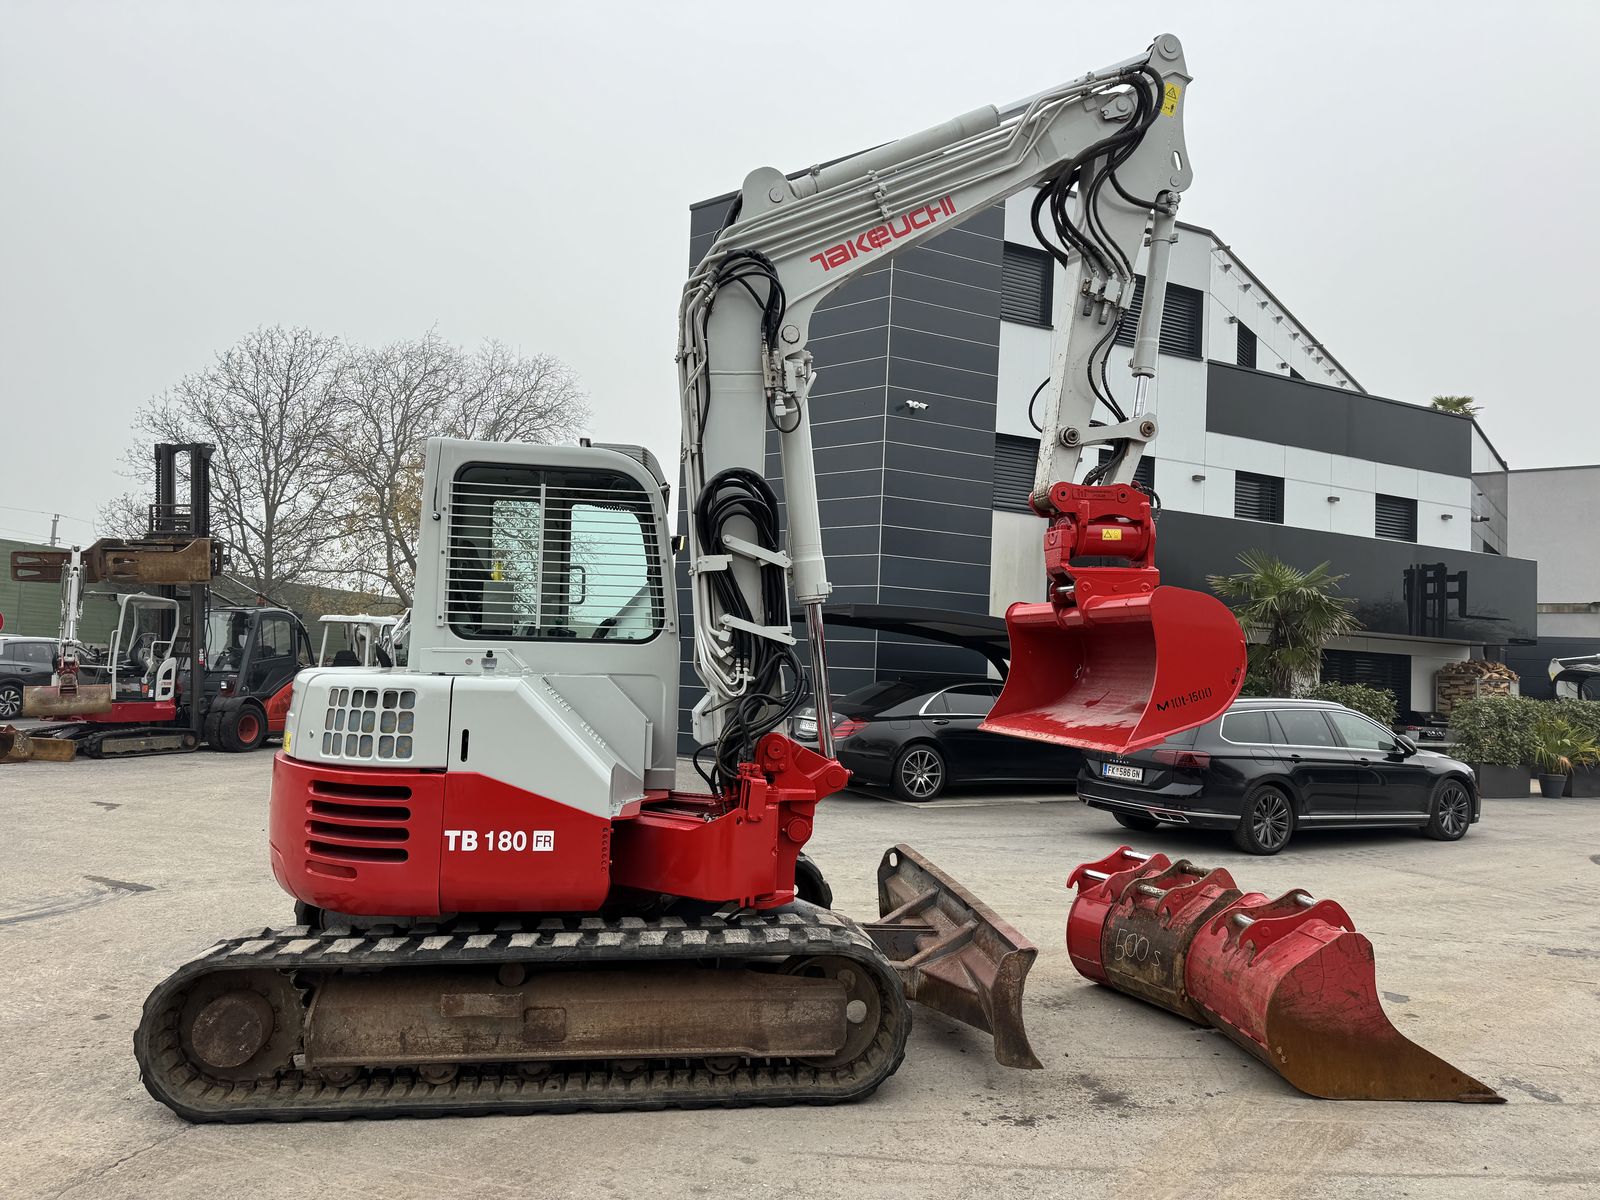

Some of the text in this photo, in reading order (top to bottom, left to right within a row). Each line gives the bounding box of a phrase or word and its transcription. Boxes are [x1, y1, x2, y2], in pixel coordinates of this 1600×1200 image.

[1107, 765, 1116, 775] FK
[1131, 769, 1141, 779] GN
[444, 830, 478, 851] TB
[484, 830, 527, 851] 180
[1115, 928, 1150, 961] 500
